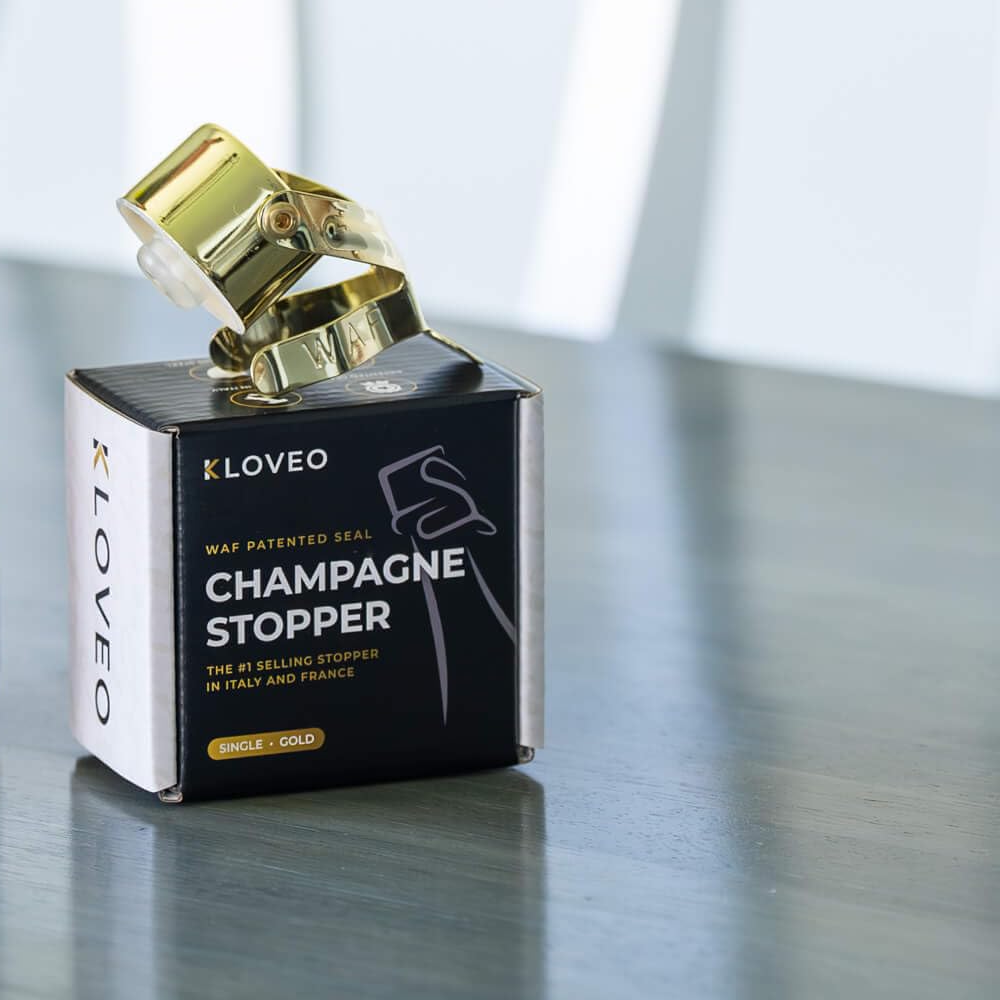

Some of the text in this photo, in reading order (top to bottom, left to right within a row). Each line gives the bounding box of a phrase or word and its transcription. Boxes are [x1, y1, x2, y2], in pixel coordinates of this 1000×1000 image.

[302, 309, 378, 370] WAF
[204, 448, 328, 481] KLOVEO
[205, 528, 373, 555] WAF PATENTED SEAL
[93, 438, 110, 726] KLOVEO
[205, 546, 466, 603] CHAMPAGNE
[206, 600, 392, 648] STOPPER
[206, 648, 379, 676] THE #1 SELLING STOPPER
[206, 666, 355, 693] IN ITALY AND FRANCE
[219, 733, 315, 754] SINGLE GOLD
